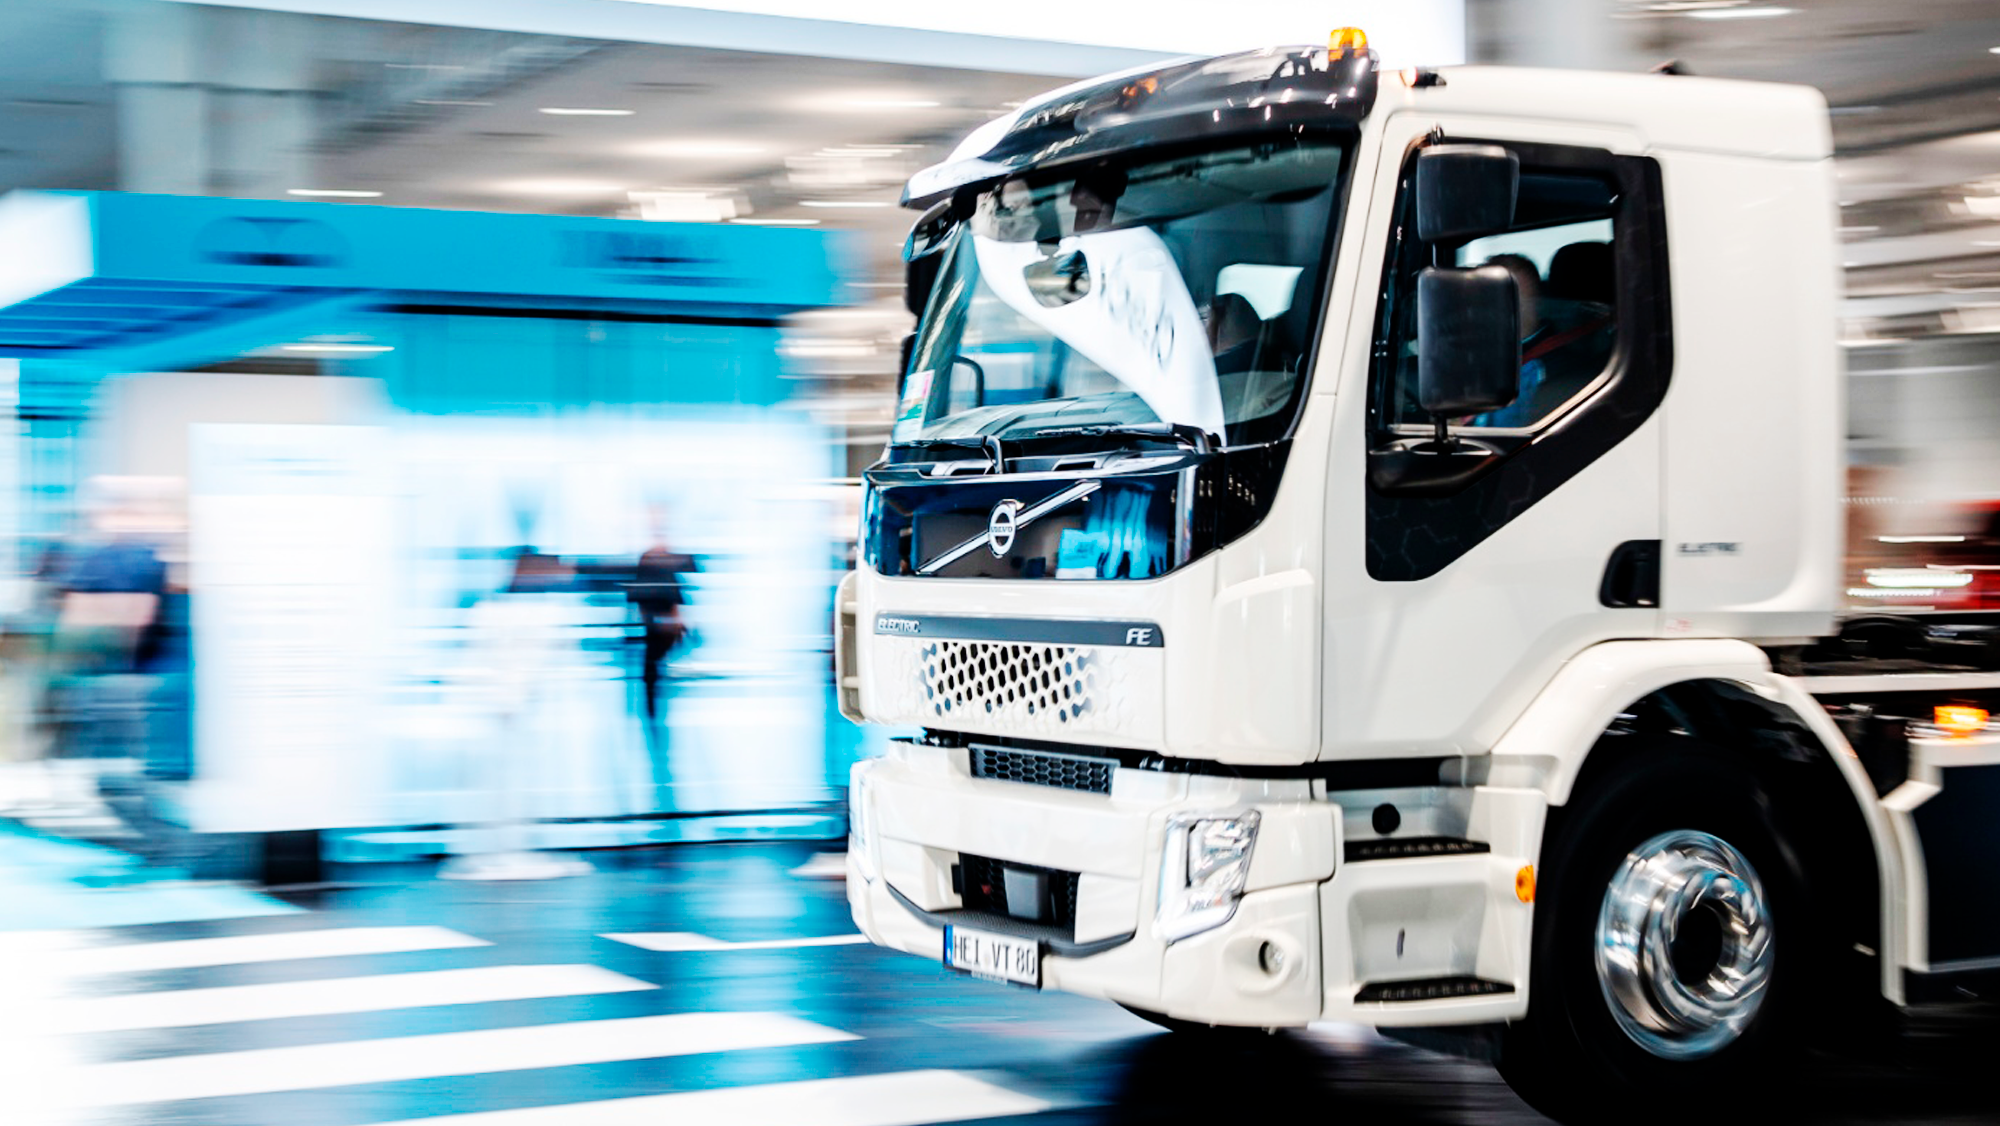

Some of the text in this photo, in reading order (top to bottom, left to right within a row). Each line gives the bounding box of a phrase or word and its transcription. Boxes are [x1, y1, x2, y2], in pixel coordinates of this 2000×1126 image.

[877, 618, 920, 633] ELECTRIC
[1125, 627, 1153, 646] FE
[953, 933, 1036, 976] HEI VT 80
